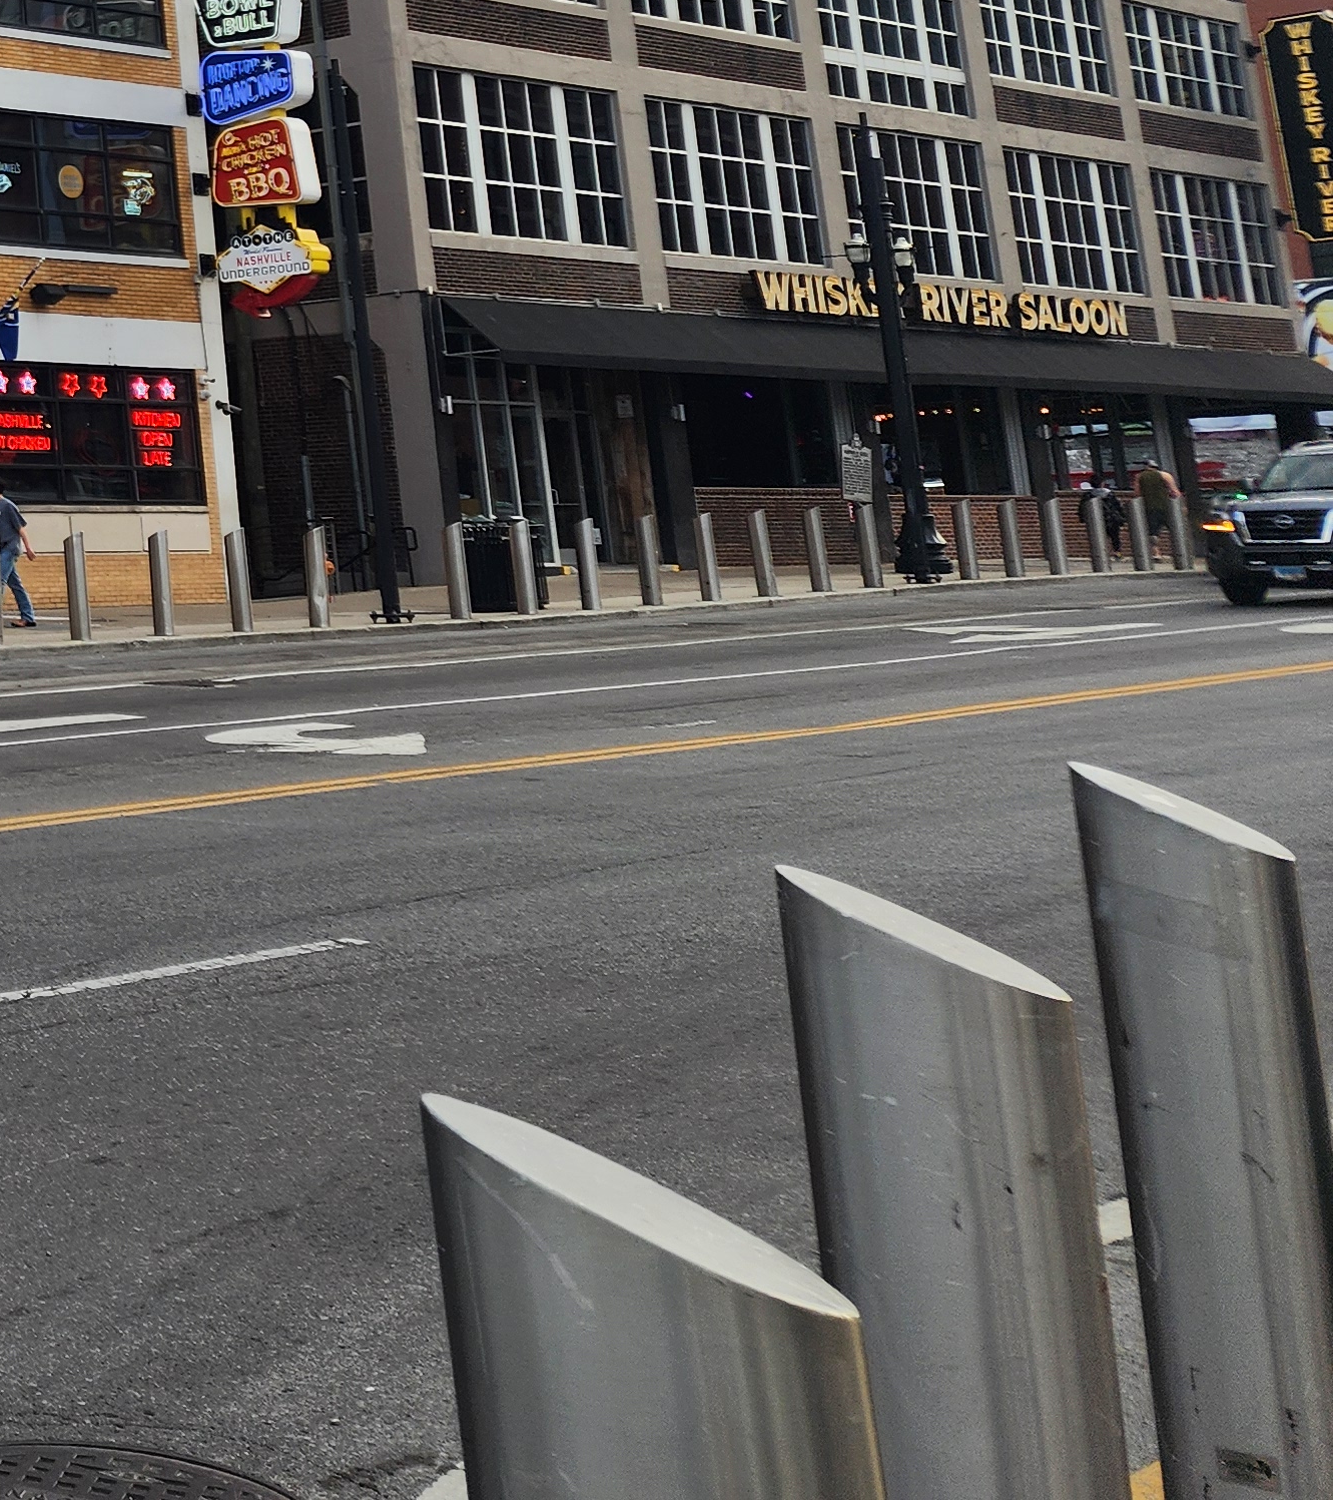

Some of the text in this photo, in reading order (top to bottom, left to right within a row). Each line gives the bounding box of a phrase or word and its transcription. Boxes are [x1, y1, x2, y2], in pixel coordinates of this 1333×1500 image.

[222, 10, 275, 36] BULL
[207, 58, 260, 86] ROOFTOP
[1284, 21, 1327, 140] WHISKEY
[209, 68, 289, 116] DANCING
[247, 129, 280, 149] HOT
[221, 143, 287, 171] CHICKEN
[228, 167, 293, 202] BBQ
[232, 231, 293, 248] AT THE
[236, 251, 292, 267] NASHVILLE
[221, 261, 310, 280] UNDERGROUND
[921, 284, 1011, 328] RIVER
[1018, 292, 1130, 336] SALOON
[132, 411, 181, 428] KITCHEN
[7, 435, 51, 451] CHICKEN
[142, 431, 174, 447] OPEN
[143, 451, 174, 467] LATE
